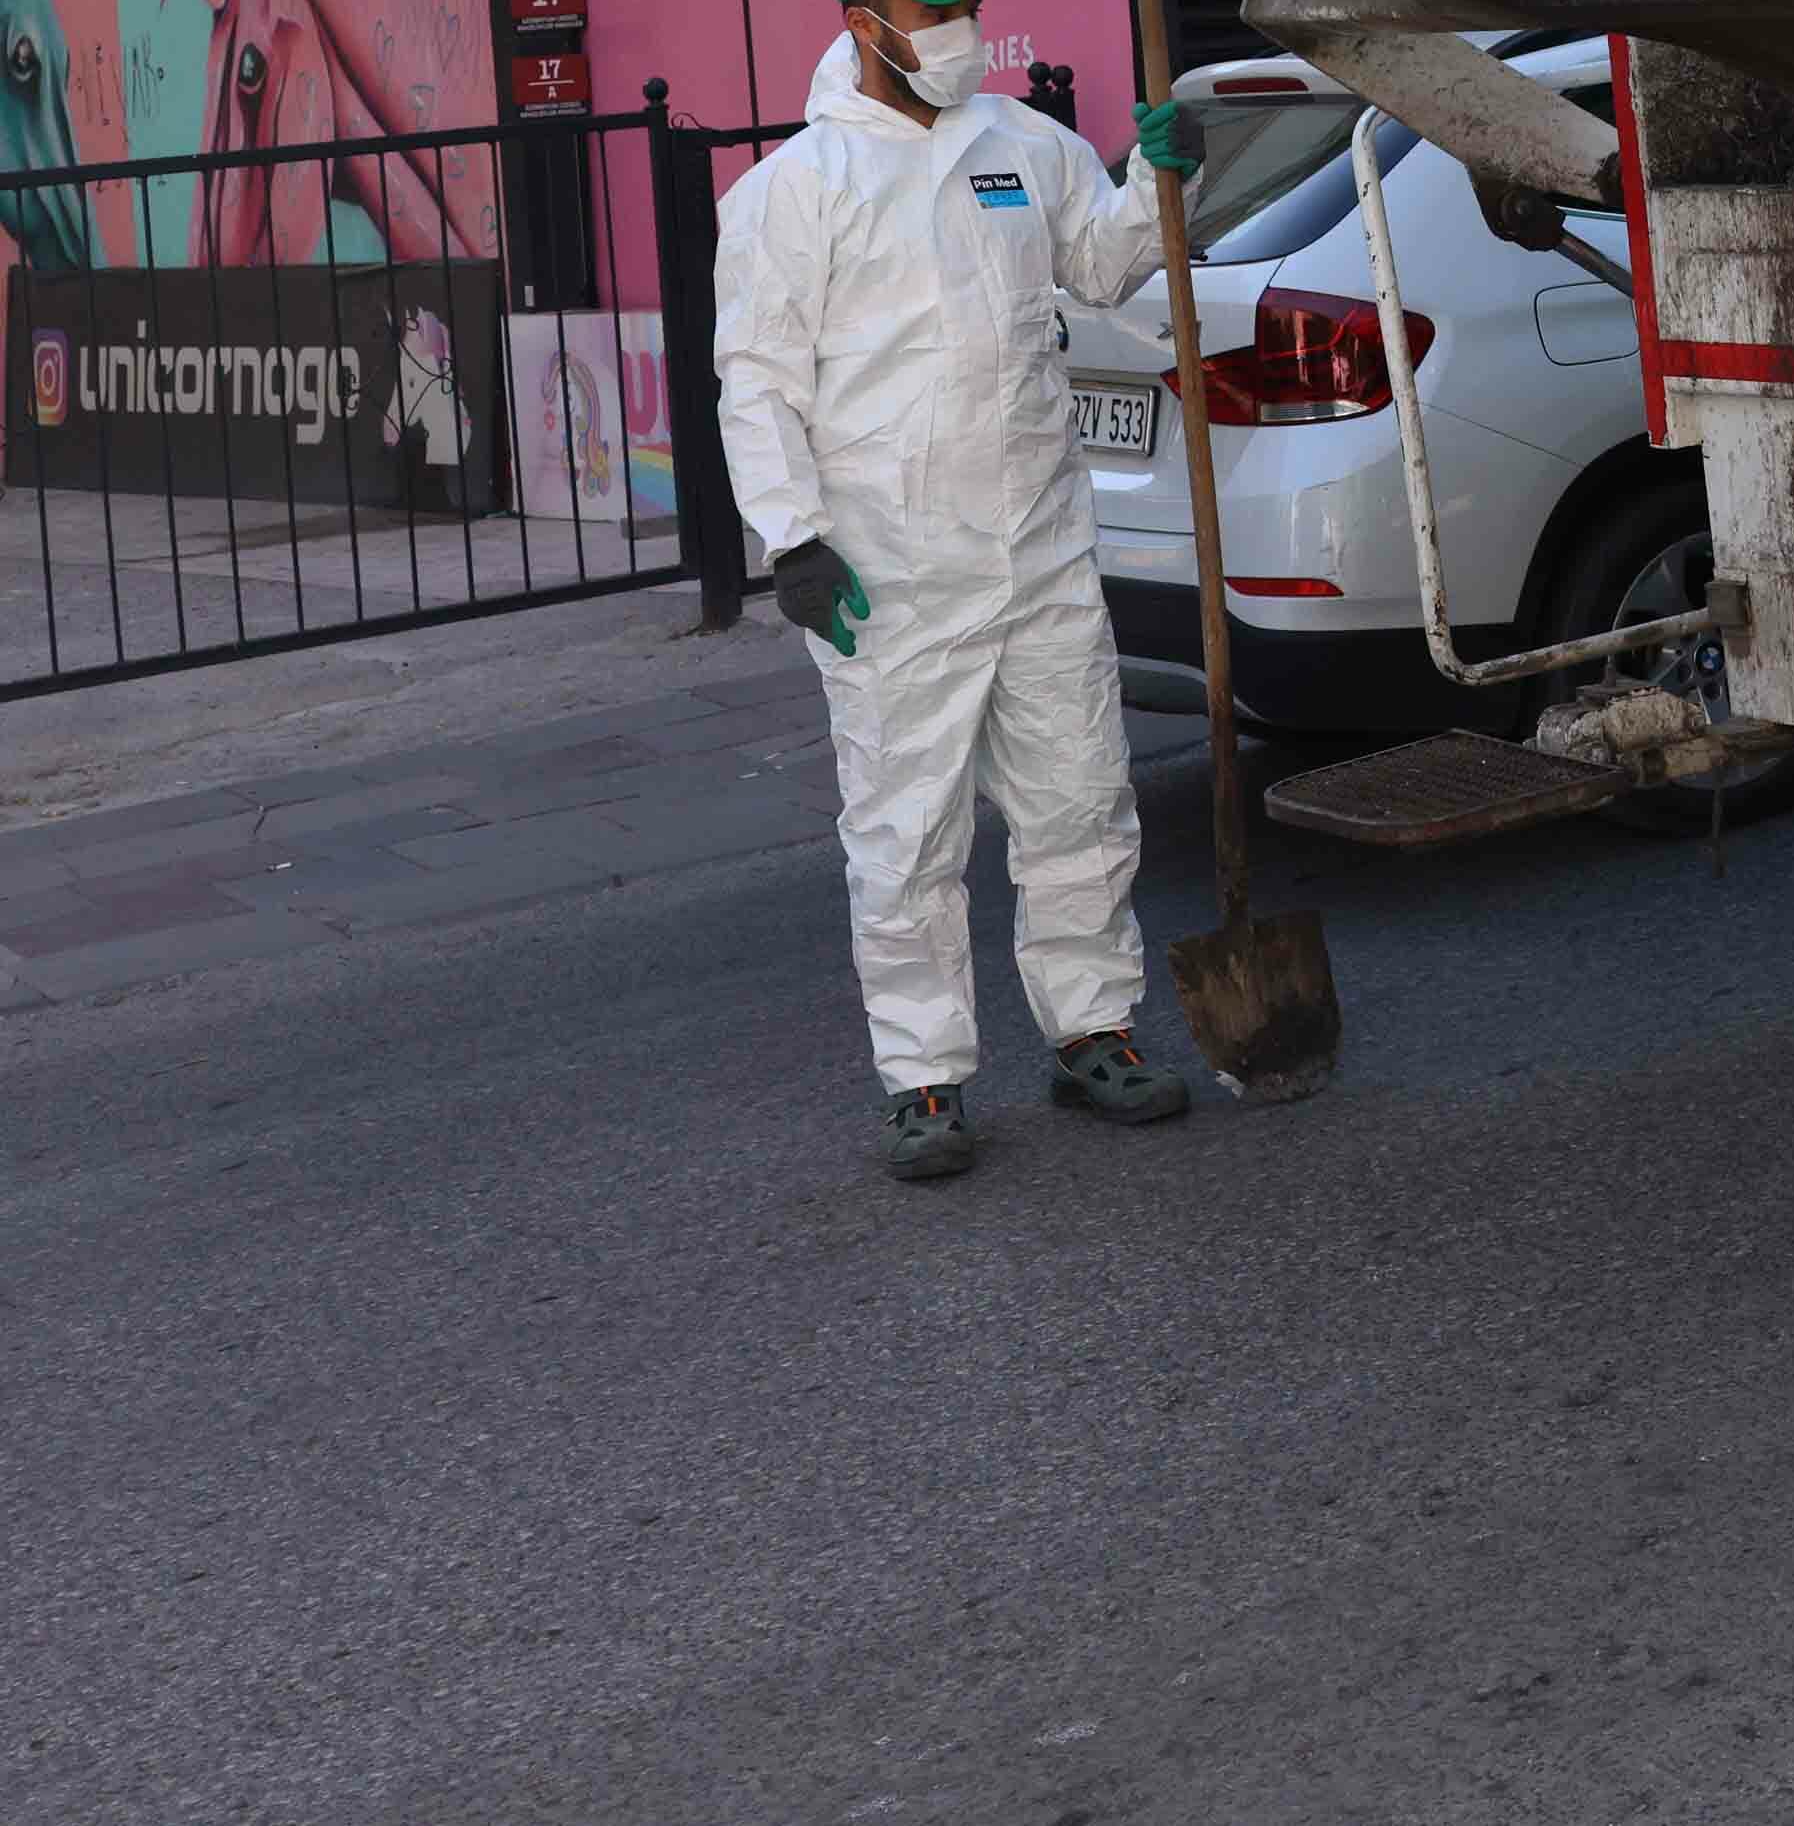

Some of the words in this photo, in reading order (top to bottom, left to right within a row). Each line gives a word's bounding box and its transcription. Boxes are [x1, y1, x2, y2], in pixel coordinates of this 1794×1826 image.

[538, 59, 561, 80] 17
[973, 178, 993, 190] Pin
[994, 177, 1018, 188] Med
[1109, 398, 1146, 445] 533
